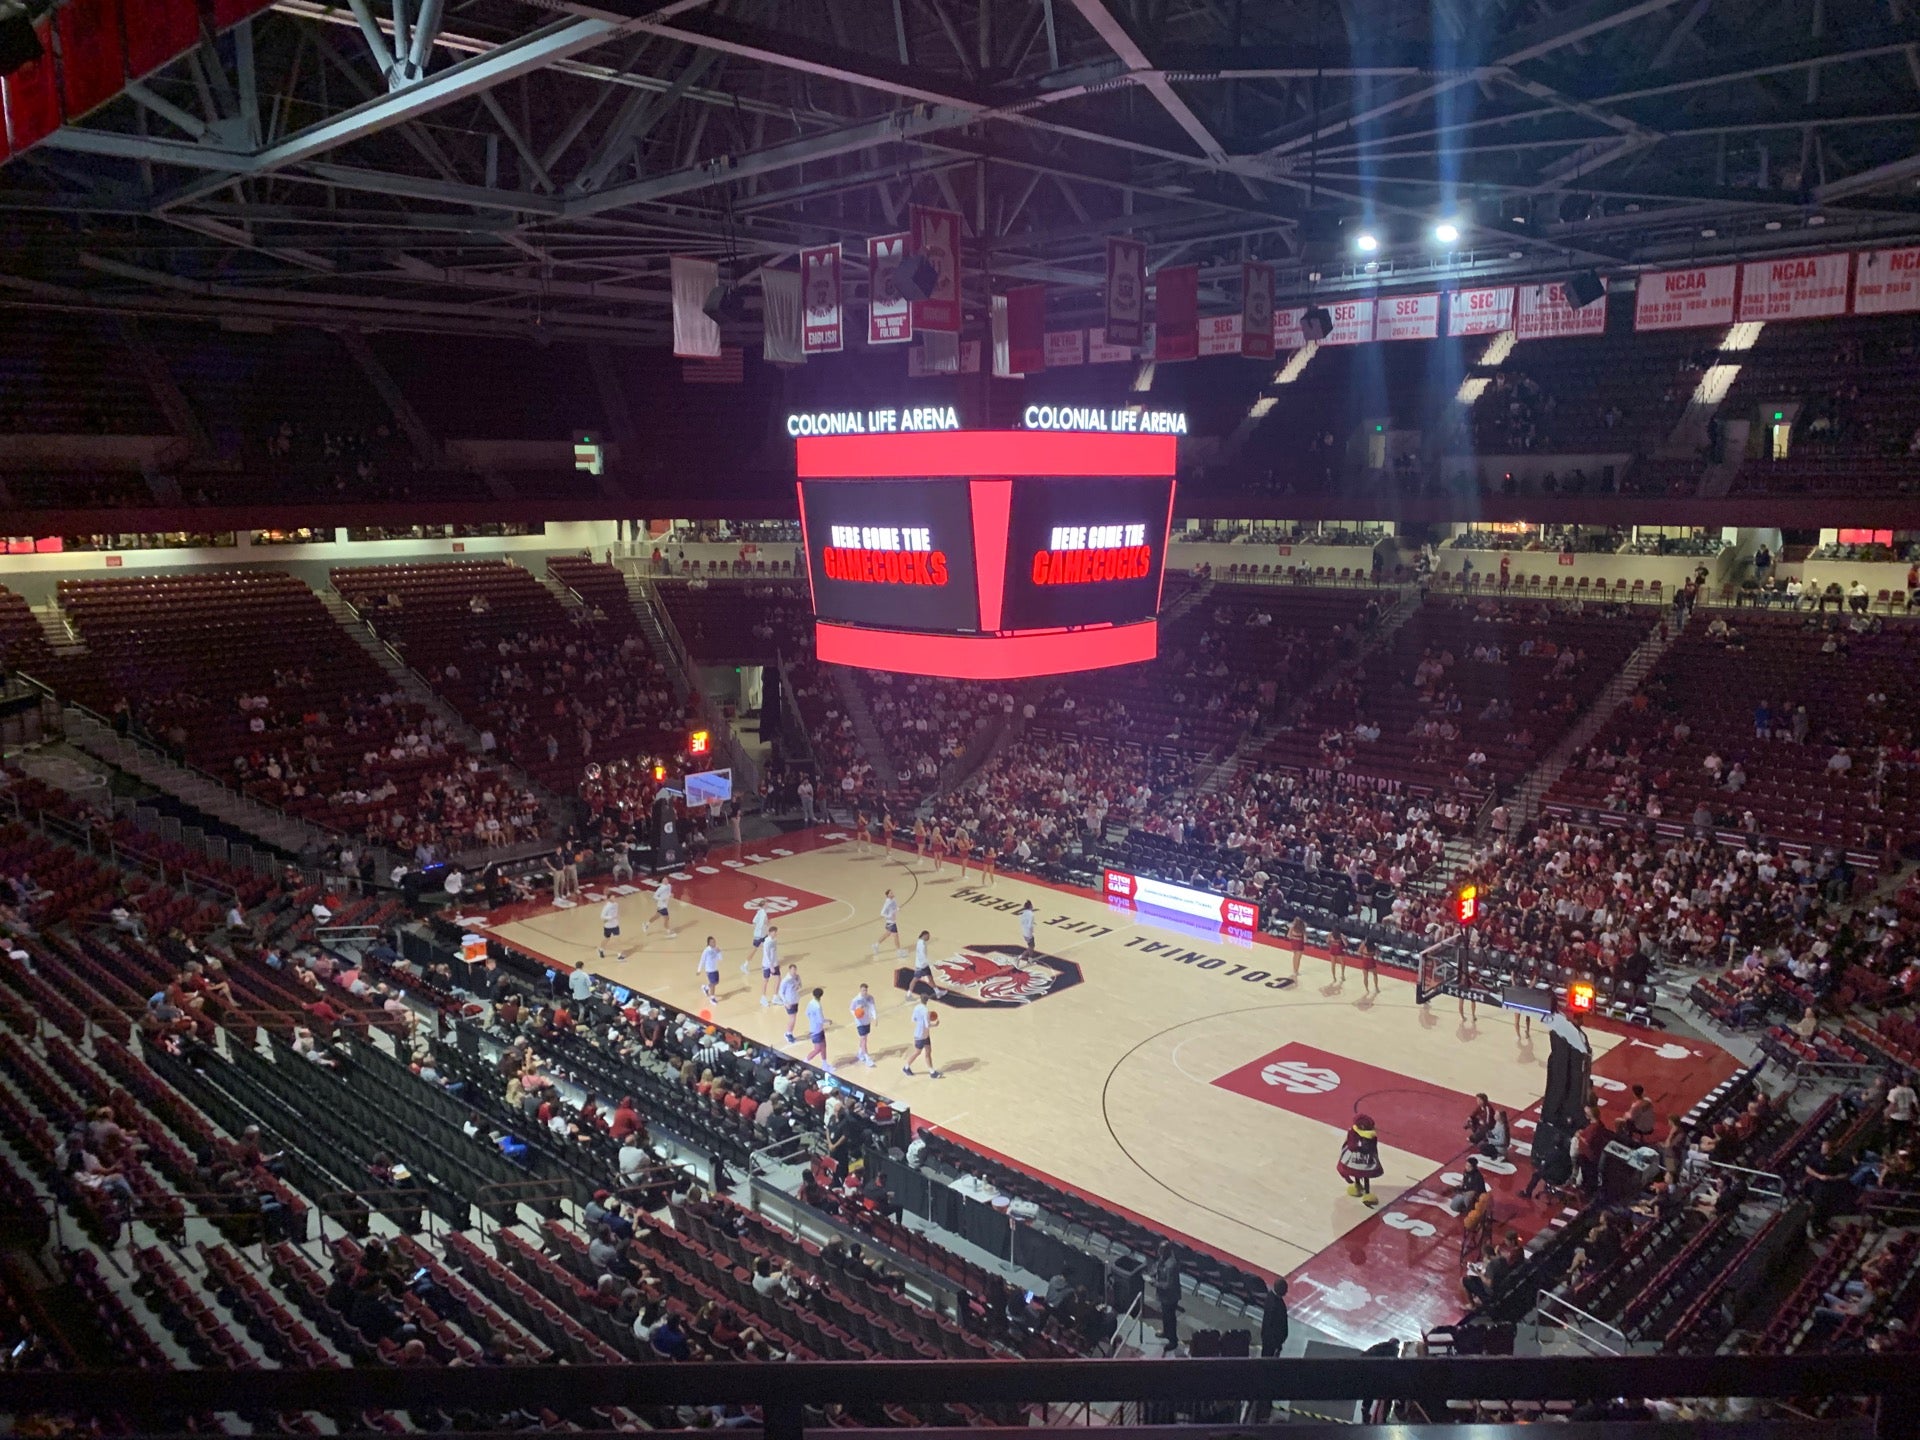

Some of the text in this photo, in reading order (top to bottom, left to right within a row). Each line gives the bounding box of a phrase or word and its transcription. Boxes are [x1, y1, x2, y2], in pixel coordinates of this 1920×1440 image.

[1772, 261, 1816, 280] NCAA
[1665, 272, 1706, 291] NCAA
[1469, 293, 1493, 309] SEC
[1549, 286, 1567, 302] SE
[1335, 306, 1356, 321] SEC
[1396, 300, 1418, 315] SEC
[880, 327, 900, 338] FULTON
[1213, 319, 1233, 334] SEC
[808, 330, 837, 346] ENGLISH
[787, 406, 959, 436] COLONIAL LIFE ARENA
[1025, 405, 1188, 434] COLONIAL LIFE ARENA
[831, 525, 931, 551] HERE COME THE
[1050, 523, 1146, 551] HERE COME THE
[823, 546, 949, 585] GAMECOCKS
[1032, 545, 1151, 585] GAMECOCKS
[692, 739, 705, 752] 30
[1307, 767, 1332, 782] THE
[1108, 873, 1131, 885] CATCH
[1108, 883, 1131, 895] GAME
[1227, 902, 1254, 915] CATCH
[1461, 898, 1474, 920] 30
[1042, 914, 1114, 938] LIFE
[1227, 912, 1254, 927] GAME
[1123, 936, 1296, 989] COLONIAL
